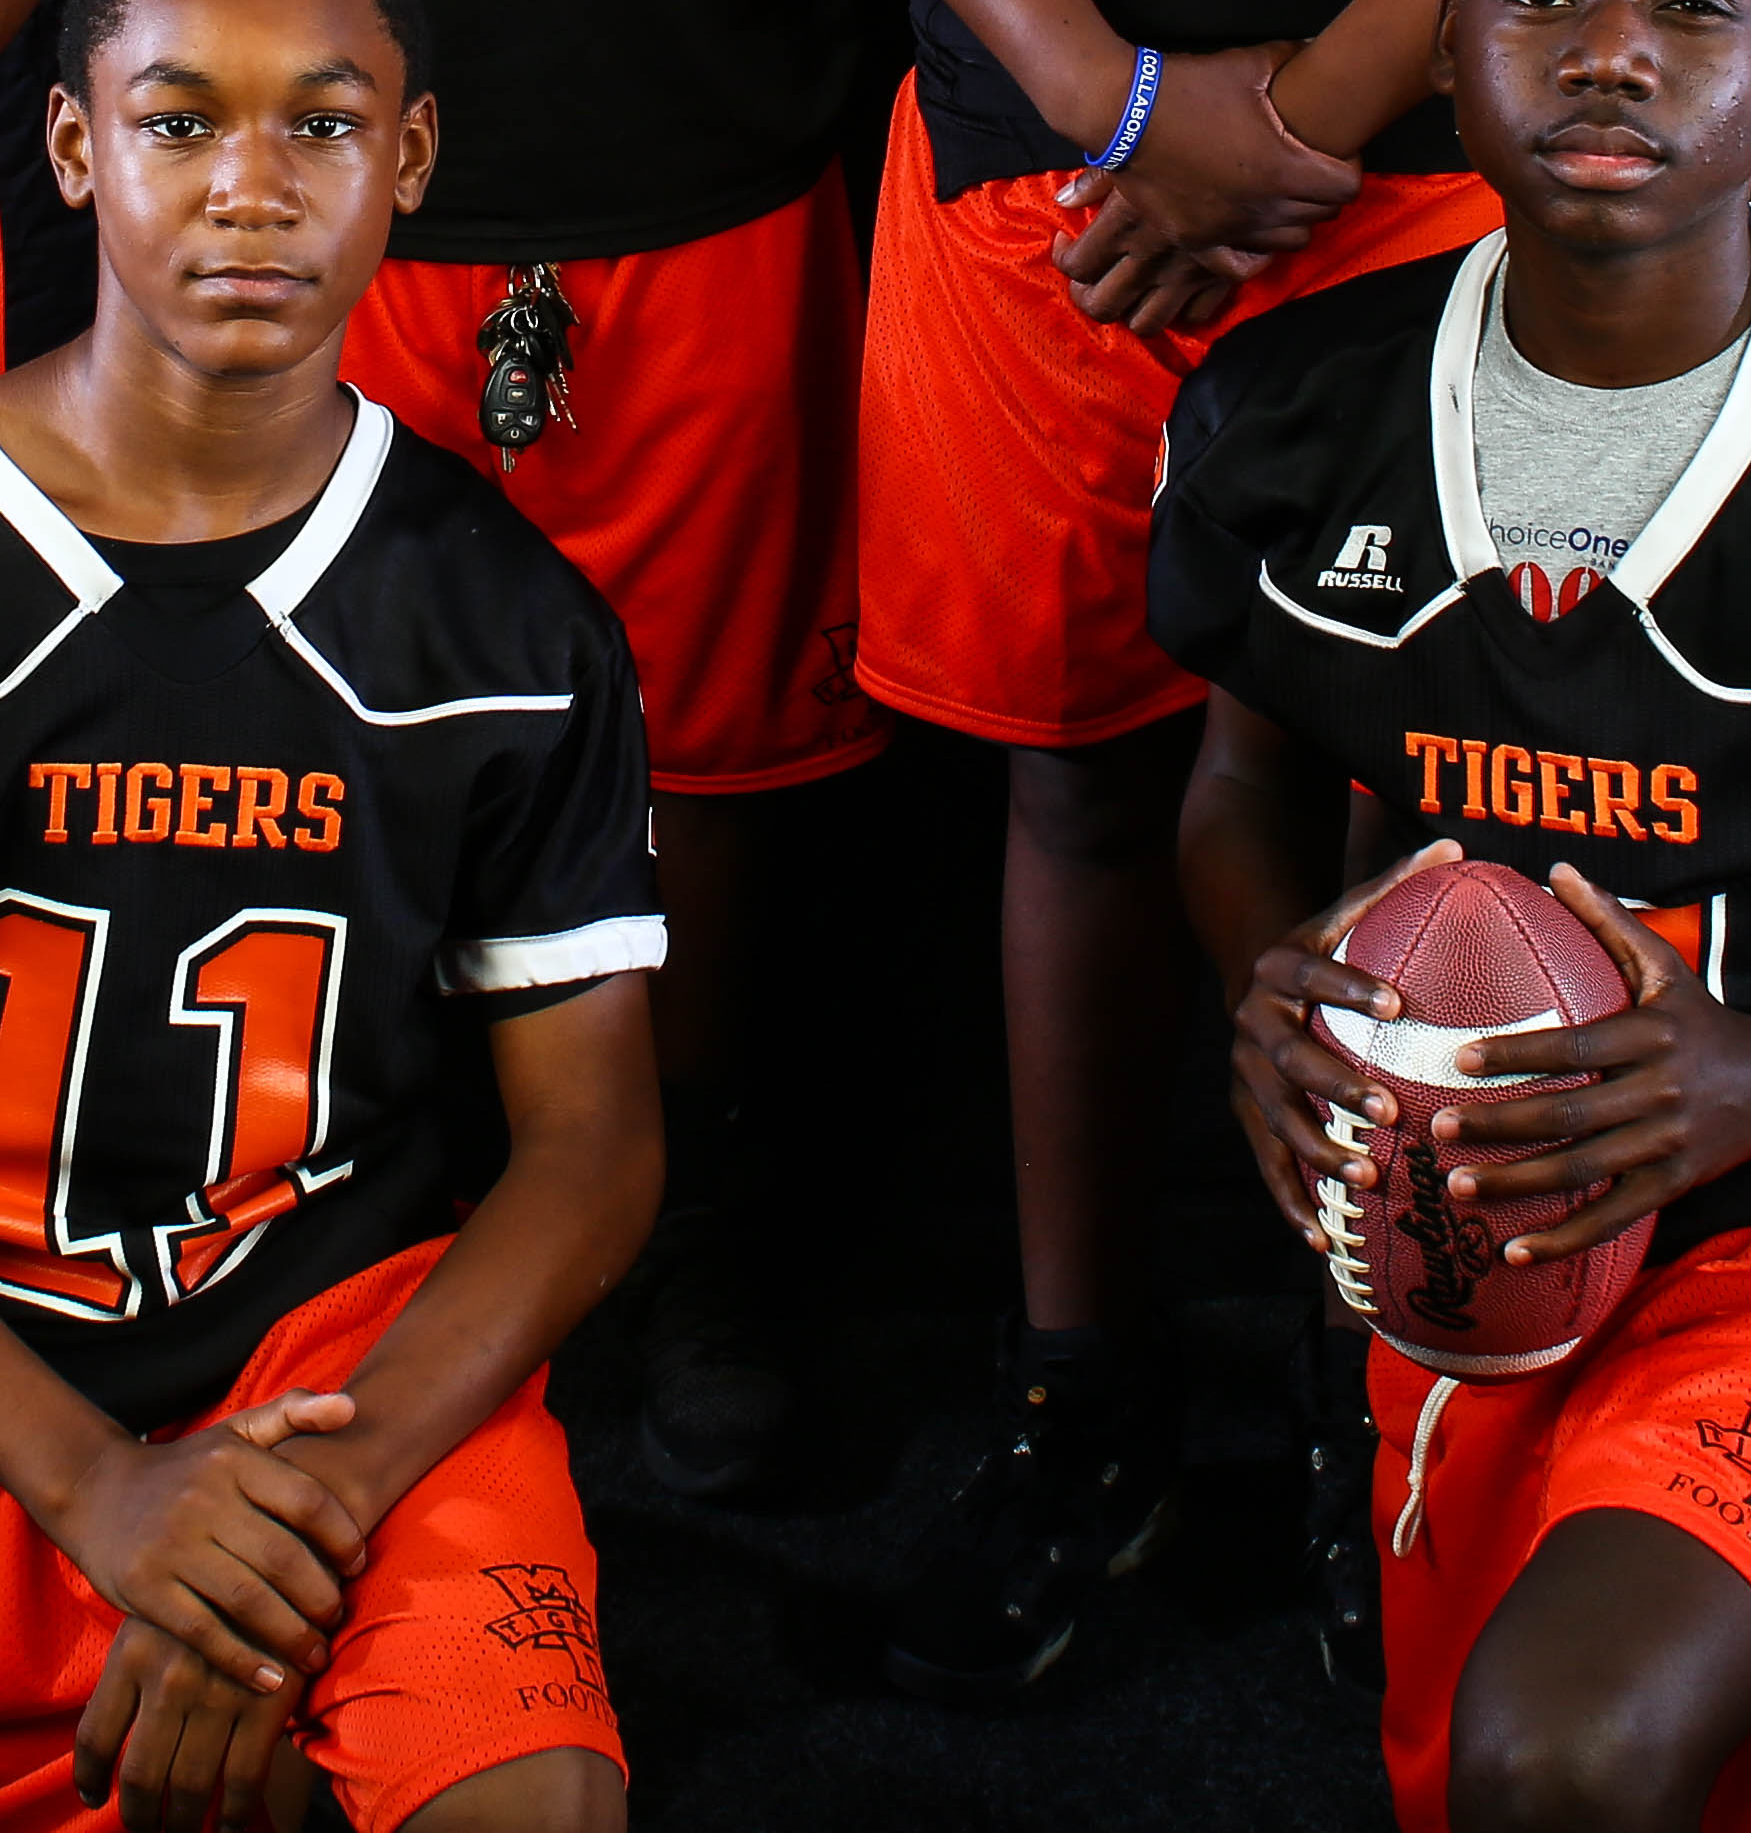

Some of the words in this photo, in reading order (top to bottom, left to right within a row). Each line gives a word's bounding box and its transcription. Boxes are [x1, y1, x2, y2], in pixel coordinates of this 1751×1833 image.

[1317, 570, 1404, 593] RUSSELL
[1490, 518, 1629, 558] hoiceOne
[30, 762, 345, 853] TIGERS
[1406, 732, 1699, 846] TIGERS
[1395, 1139, 1478, 1331] Rawlings
